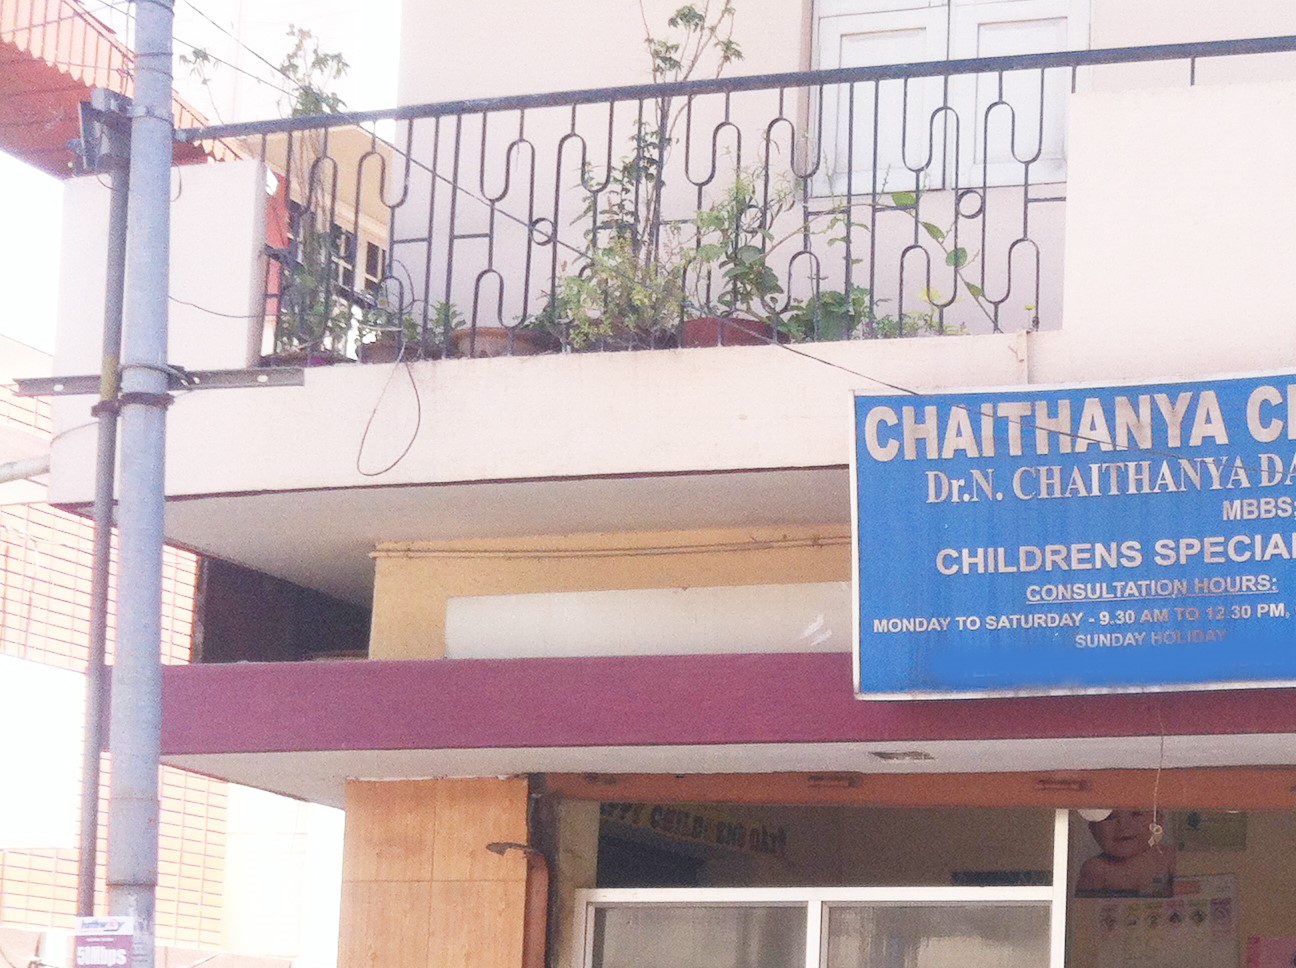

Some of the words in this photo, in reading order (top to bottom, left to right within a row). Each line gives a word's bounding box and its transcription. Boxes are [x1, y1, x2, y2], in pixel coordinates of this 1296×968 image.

[863, 390, 1230, 462] CHAITHANYA
[925, 469, 1004, 503] Dr.N.
[1011, 455, 1251, 501] CHAITHANYA
[936, 541, 1143, 575] CHILDRENS
[1026, 580, 1188, 603] CONSULTATION
[1194, 574, 1279, 597] HOURS:
[873, 617, 951, 633] MONDAY
[955, 615, 981, 630] TO
[985, 612, 1084, 630] SATURDAY
[1099, 609, 1136, 626] 9.30
[1139, 609, 1169, 623] AM
[1173, 607, 1201, 621] TO
[1206, 605, 1252, 620] 12.30
[1075, 632, 1146, 648] SUNDAY
[1150, 629, 1227, 646] HOLIDAY
